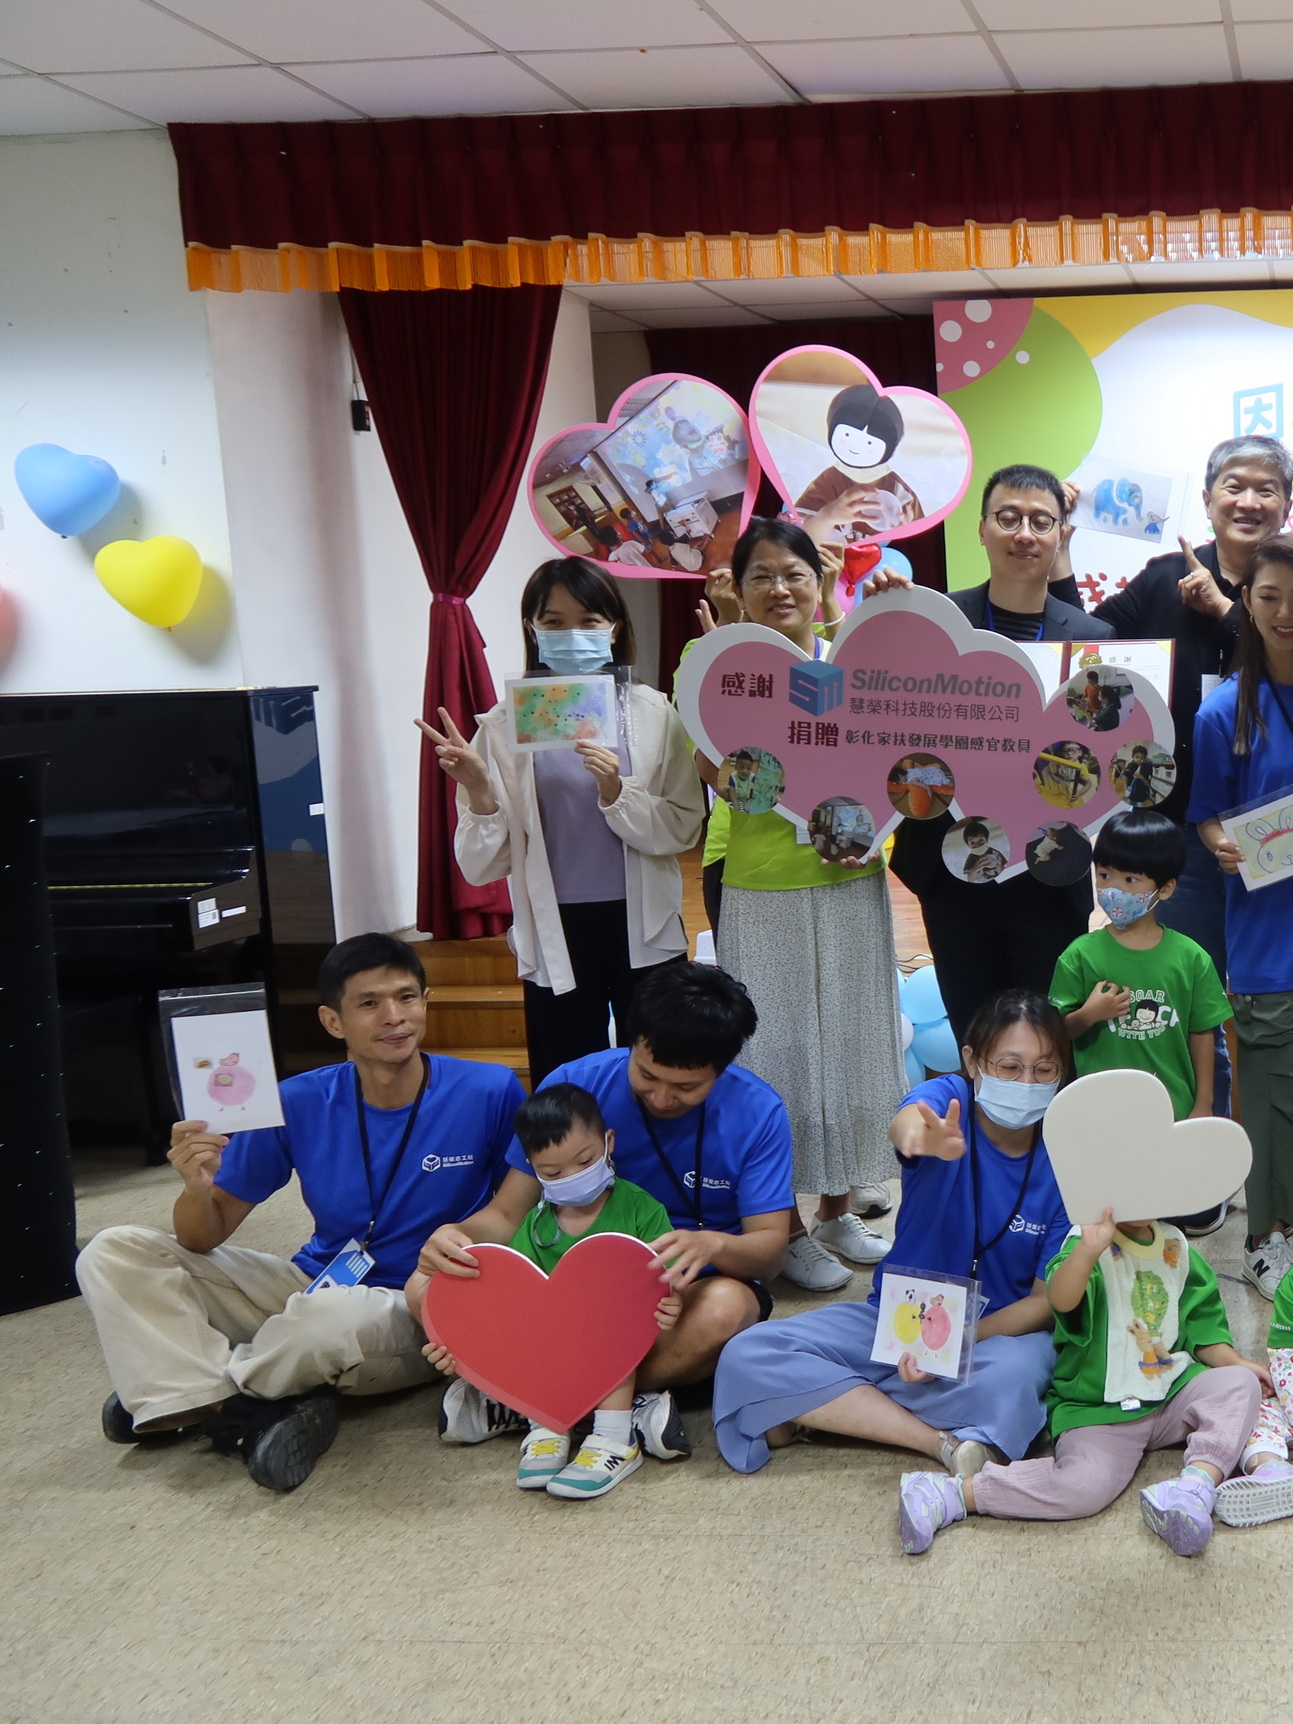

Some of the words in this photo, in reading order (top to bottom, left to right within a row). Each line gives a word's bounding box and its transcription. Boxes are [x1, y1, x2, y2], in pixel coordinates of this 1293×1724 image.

[720, 672, 774, 699] 感謝
[850, 668, 1022, 699] SiliconMotion
[848, 697, 1020, 723] 慧榮科技股份有限公司
[787, 720, 839, 748] 捐贈
[845, 730, 1031, 754] 彰化家扶發展學園感官教具
[1129, 989, 1165, 1003] SOAR
